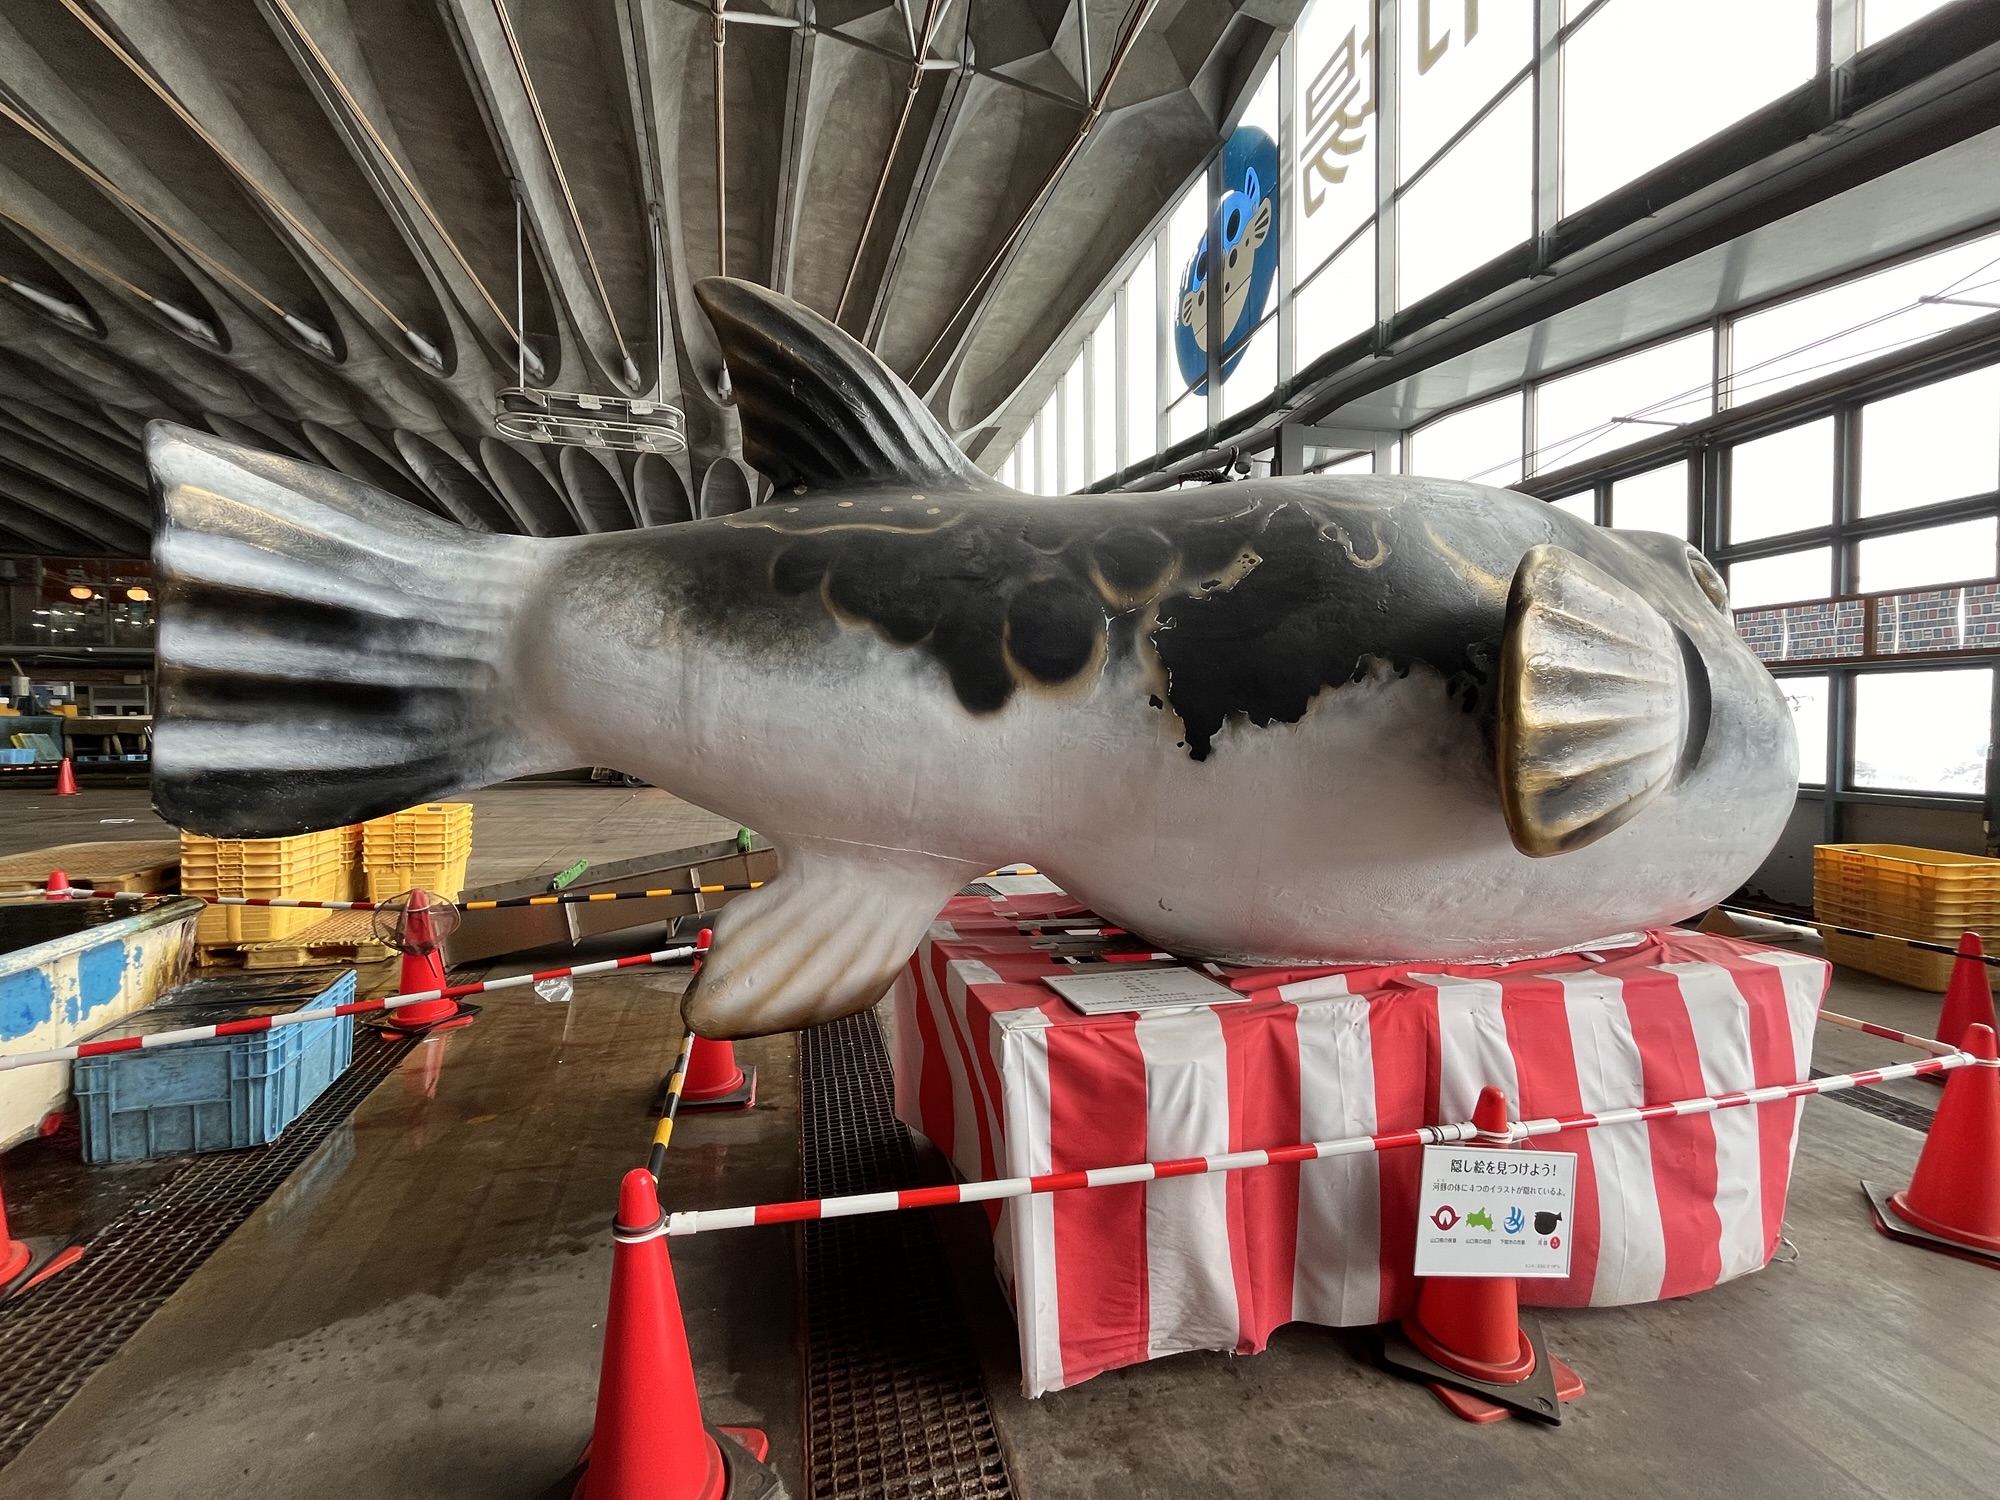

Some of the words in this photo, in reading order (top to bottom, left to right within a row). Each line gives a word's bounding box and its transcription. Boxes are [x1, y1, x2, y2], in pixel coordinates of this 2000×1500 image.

[1450, 1159, 1557, 1176] 隠し絵を見つけよう!
